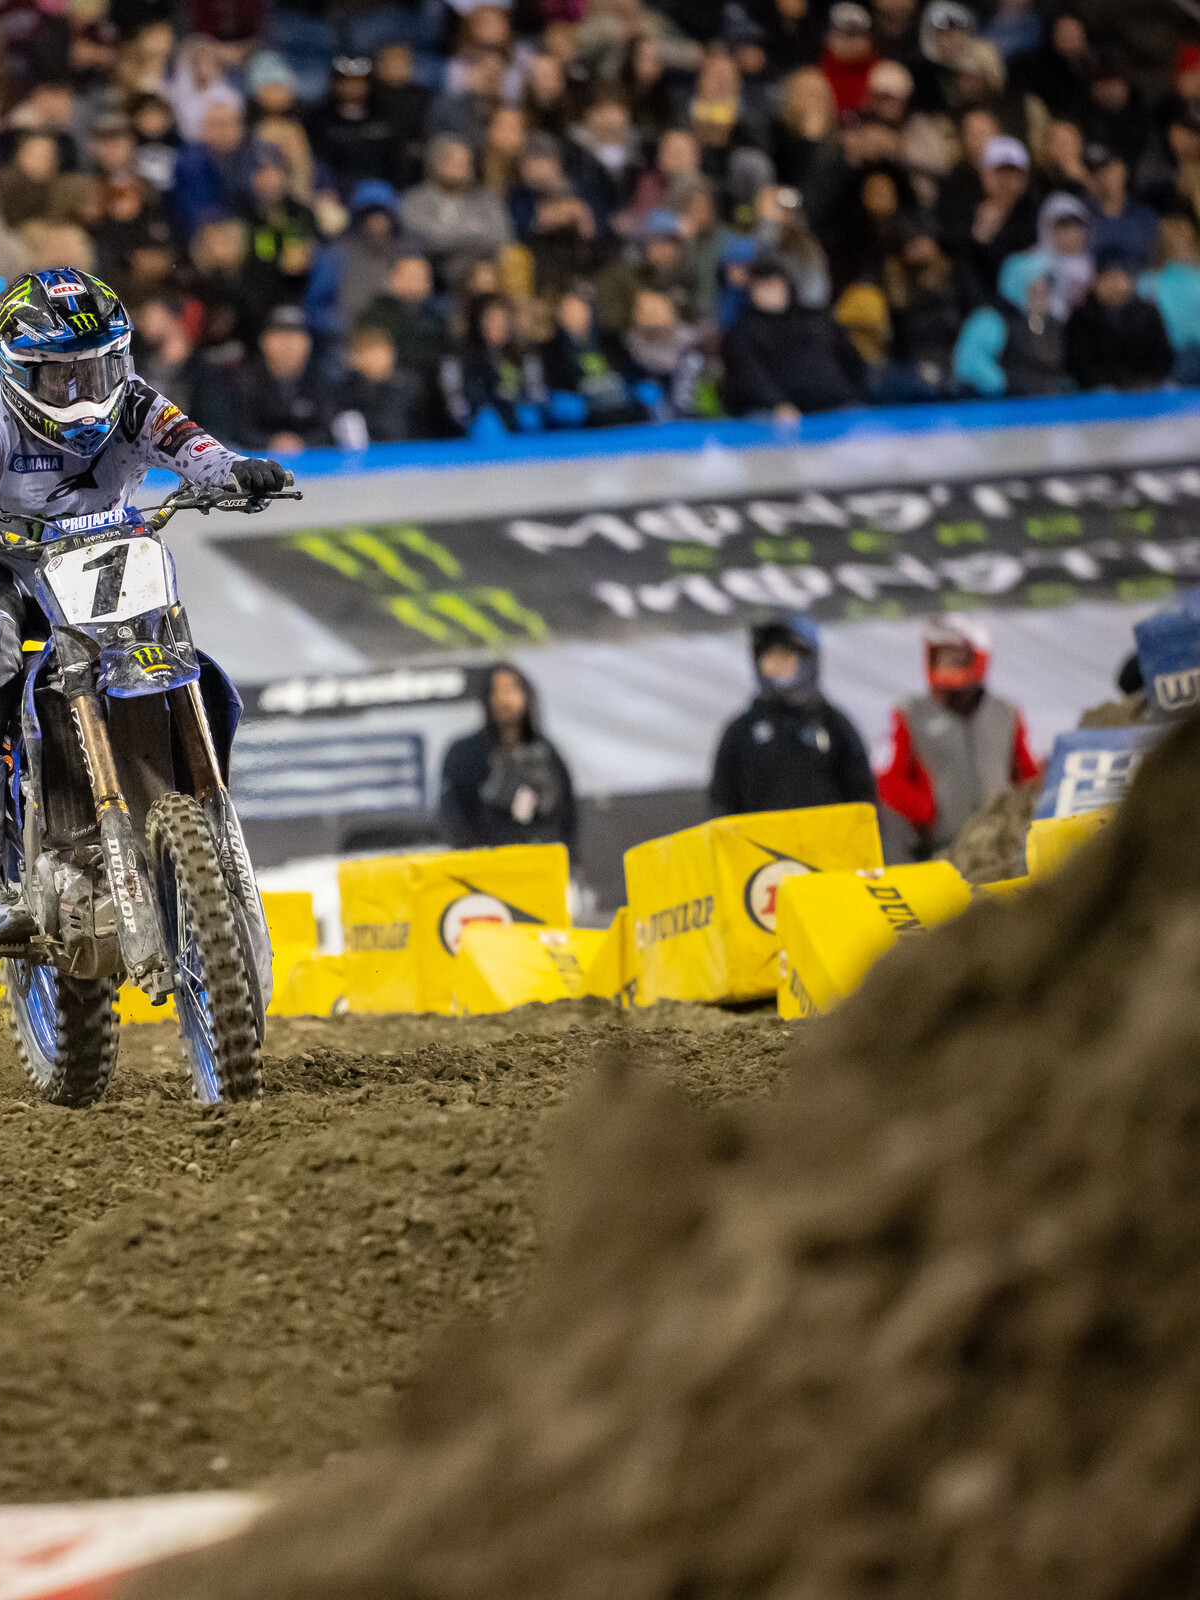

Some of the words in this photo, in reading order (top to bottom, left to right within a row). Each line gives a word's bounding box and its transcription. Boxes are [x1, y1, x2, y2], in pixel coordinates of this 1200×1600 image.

[53, 286, 81, 295] BELL
[24, 457, 59, 471] MAHA
[217, 499, 248, 507] ARC
[61, 508, 123, 531] PROTAPER
[82, 543, 130, 619] 1
[226, 820, 258, 915] DUNLOP
[107, 838, 137, 933] DUNLOP
